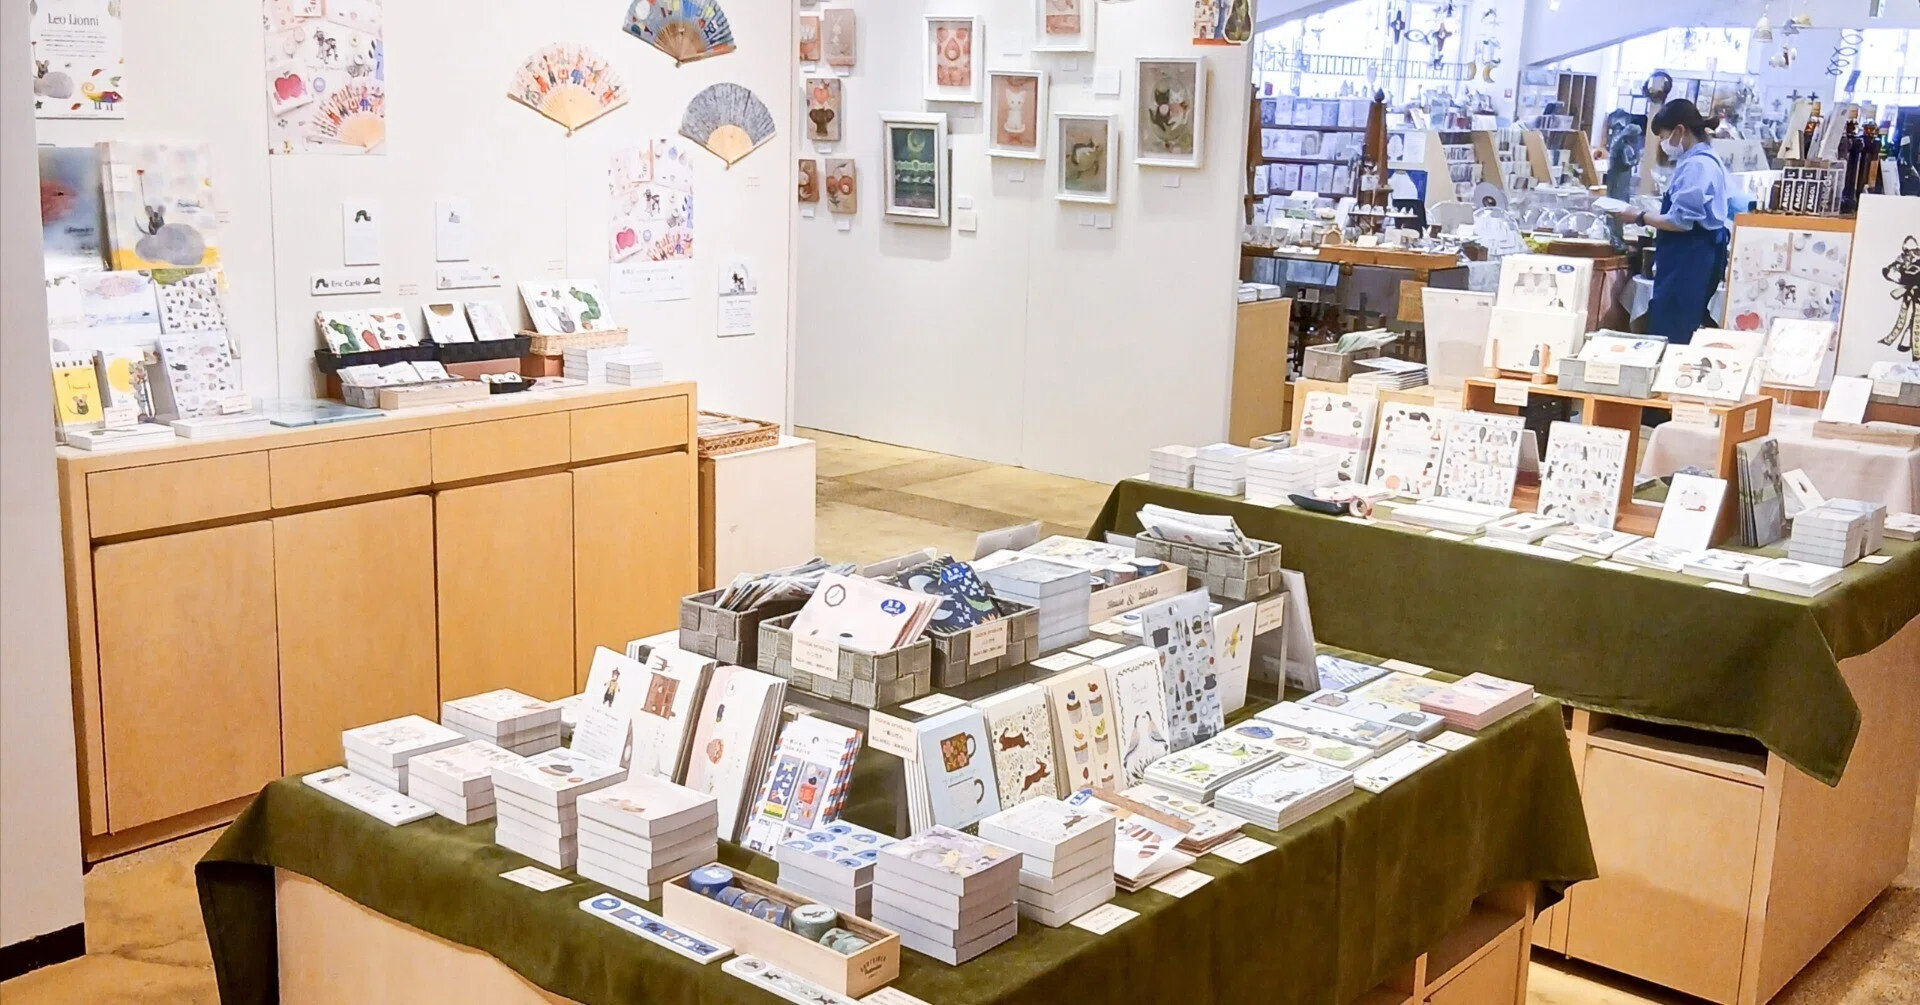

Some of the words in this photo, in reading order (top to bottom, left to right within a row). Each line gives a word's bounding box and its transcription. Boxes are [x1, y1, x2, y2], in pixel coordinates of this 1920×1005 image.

[47, 12, 66, 25] Leo
[68, 13, 99, 26] Lionni
[1782, 183, 1791, 208] ARGOL
[1794, 184, 1803, 208] ARGOL
[1807, 185, 1816, 210] ARGOL
[344, 279, 361, 287] Carle
